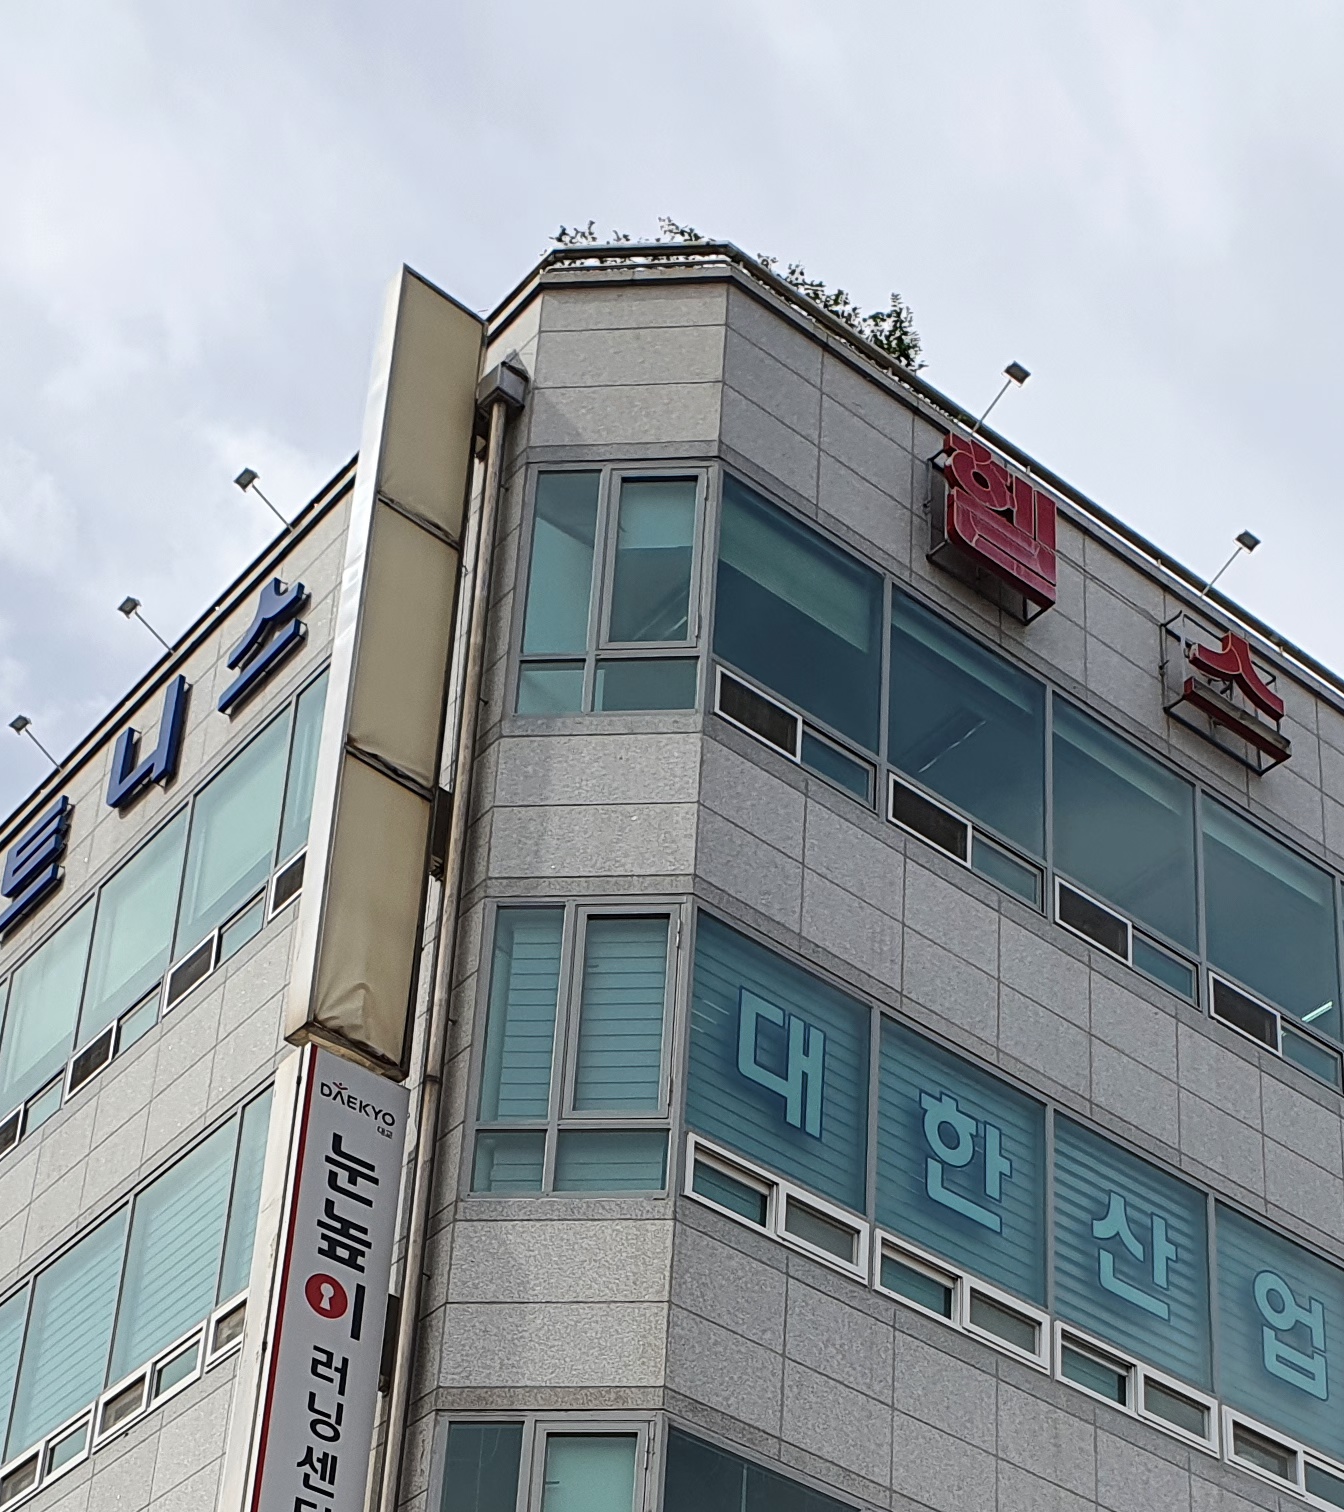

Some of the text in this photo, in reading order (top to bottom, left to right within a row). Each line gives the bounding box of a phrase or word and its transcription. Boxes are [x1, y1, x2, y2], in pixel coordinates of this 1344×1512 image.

[943, 430, 1292, 765] 헬스
[320, 1082, 395, 1127] DAEKYO
[304, 1131, 380, 1341] 눈높이
